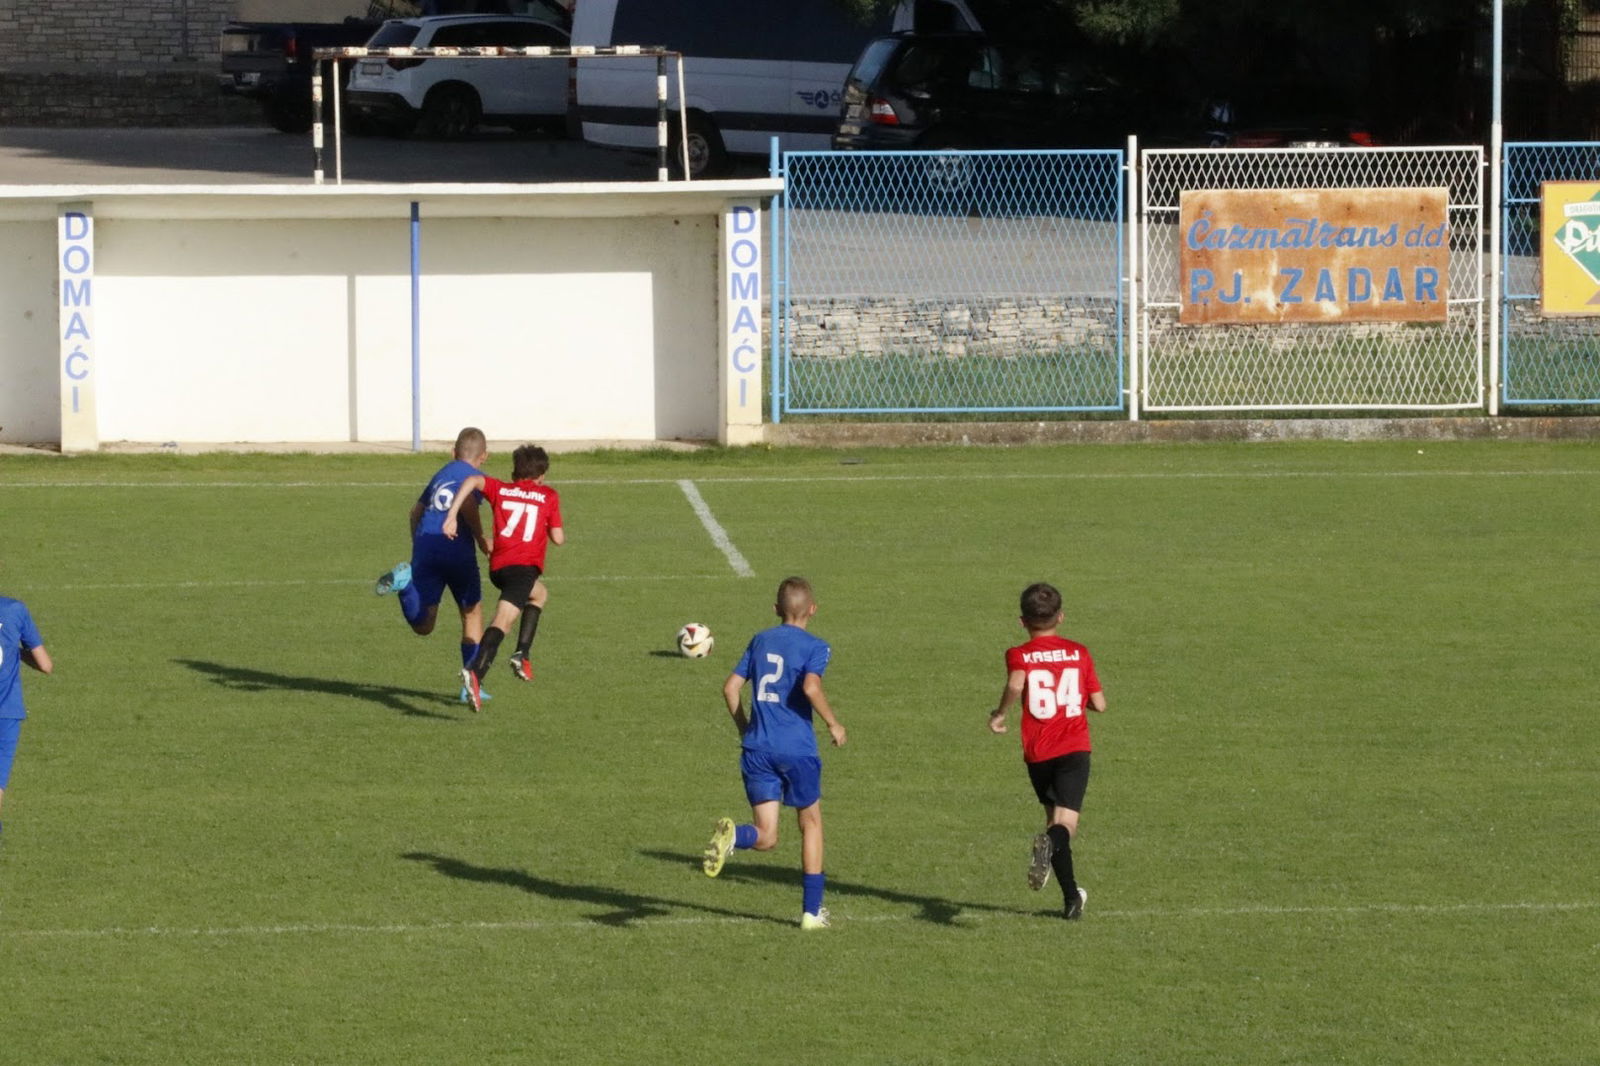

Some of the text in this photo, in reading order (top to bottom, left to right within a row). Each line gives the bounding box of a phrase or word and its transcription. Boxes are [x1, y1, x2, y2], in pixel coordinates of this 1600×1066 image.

[1187, 211, 1398, 250] Čazmatrans
[731, 206, 758, 407] DOMAĆI
[1280, 267, 1439, 303] ZADAR
[63, 212, 91, 413] DOMAĆI
[500, 501, 539, 542] 71
[757, 653, 784, 703] 2
[1028, 668, 1082, 719] 64
